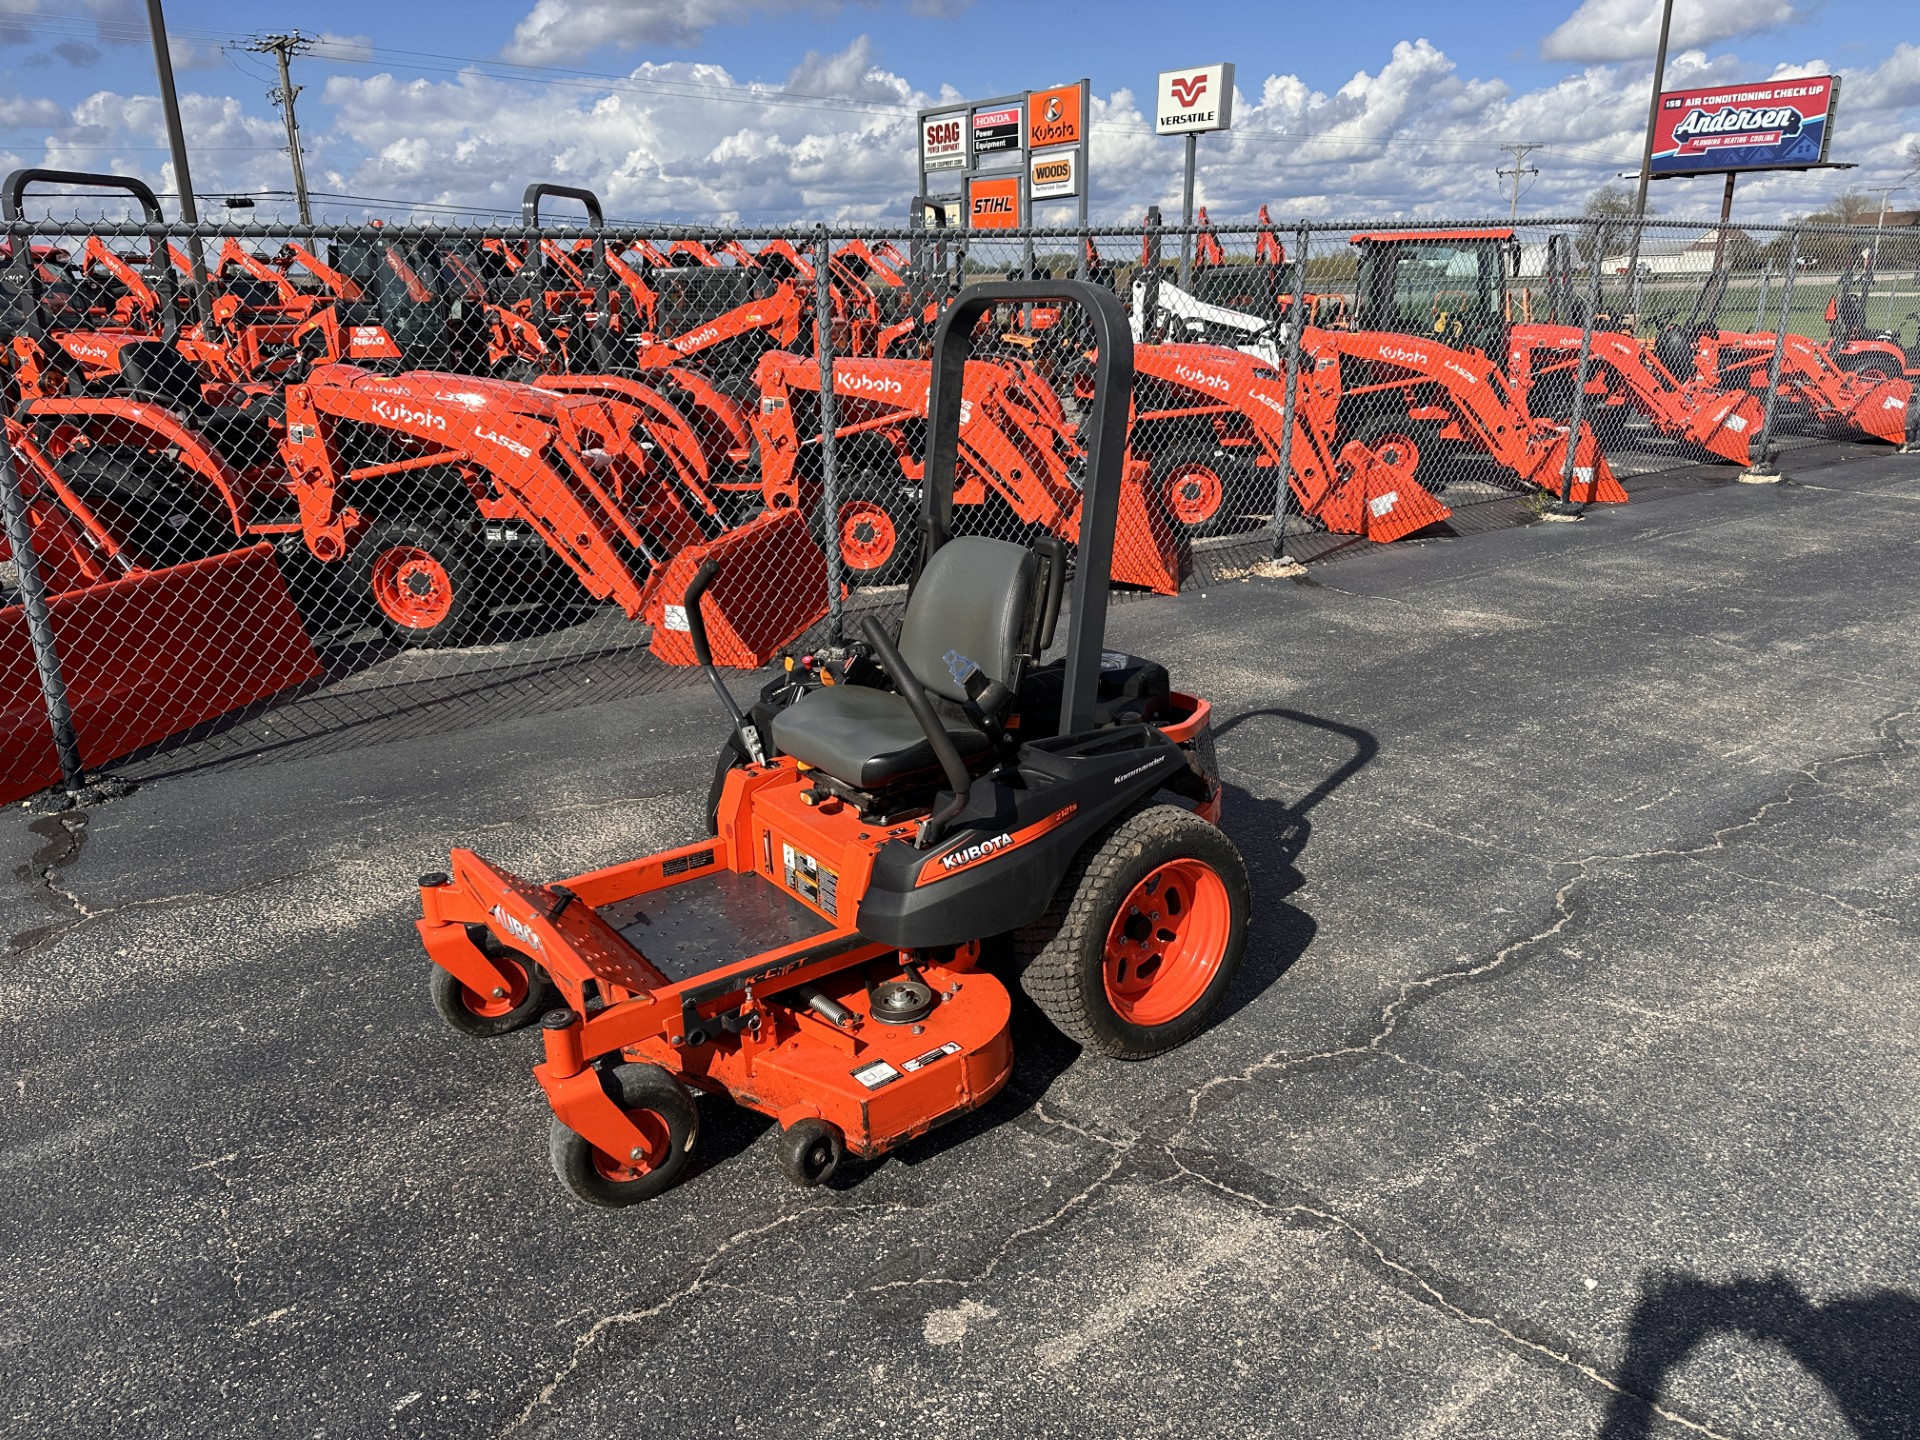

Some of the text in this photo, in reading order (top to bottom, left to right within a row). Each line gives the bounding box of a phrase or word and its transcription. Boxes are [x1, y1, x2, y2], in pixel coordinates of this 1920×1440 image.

[1684, 97, 1702, 107] AIR
[1702, 91, 1772, 105] CONDITIONING
[1773, 86, 1808, 99] CHECK
[1808, 85, 1824, 95] UP
[975, 114, 1010, 126] HONDA
[1160, 110, 1215, 126] VERSATILE
[1675, 108, 1792, 134] Andersen
[927, 122, 960, 146] SCAG
[975, 129, 993, 138] Power
[1031, 121, 1074, 141] Kubota
[1692, 134, 1775, 147] PLUMBING HEATING COOLING
[927, 142, 960, 154] POWER EQUIPMENT
[975, 139, 1006, 150] Equipment
[1035, 164, 1069, 180] WOODS
[973, 197, 1013, 215] STIHL
[674, 327, 719, 352] Kubota
[1560, 338, 1582, 346] Kubo
[69, 342, 108, 358] Kubota
[1379, 345, 1428, 364] Kubota
[837, 371, 902, 393] Kubota
[1174, 363, 1230, 391] Kubota
[371, 398, 446, 431] Kubota
[1114, 755, 1166, 784] Kommander
[942, 833, 1014, 870] KUBOTA
[489, 903, 547, 956] KUBO
